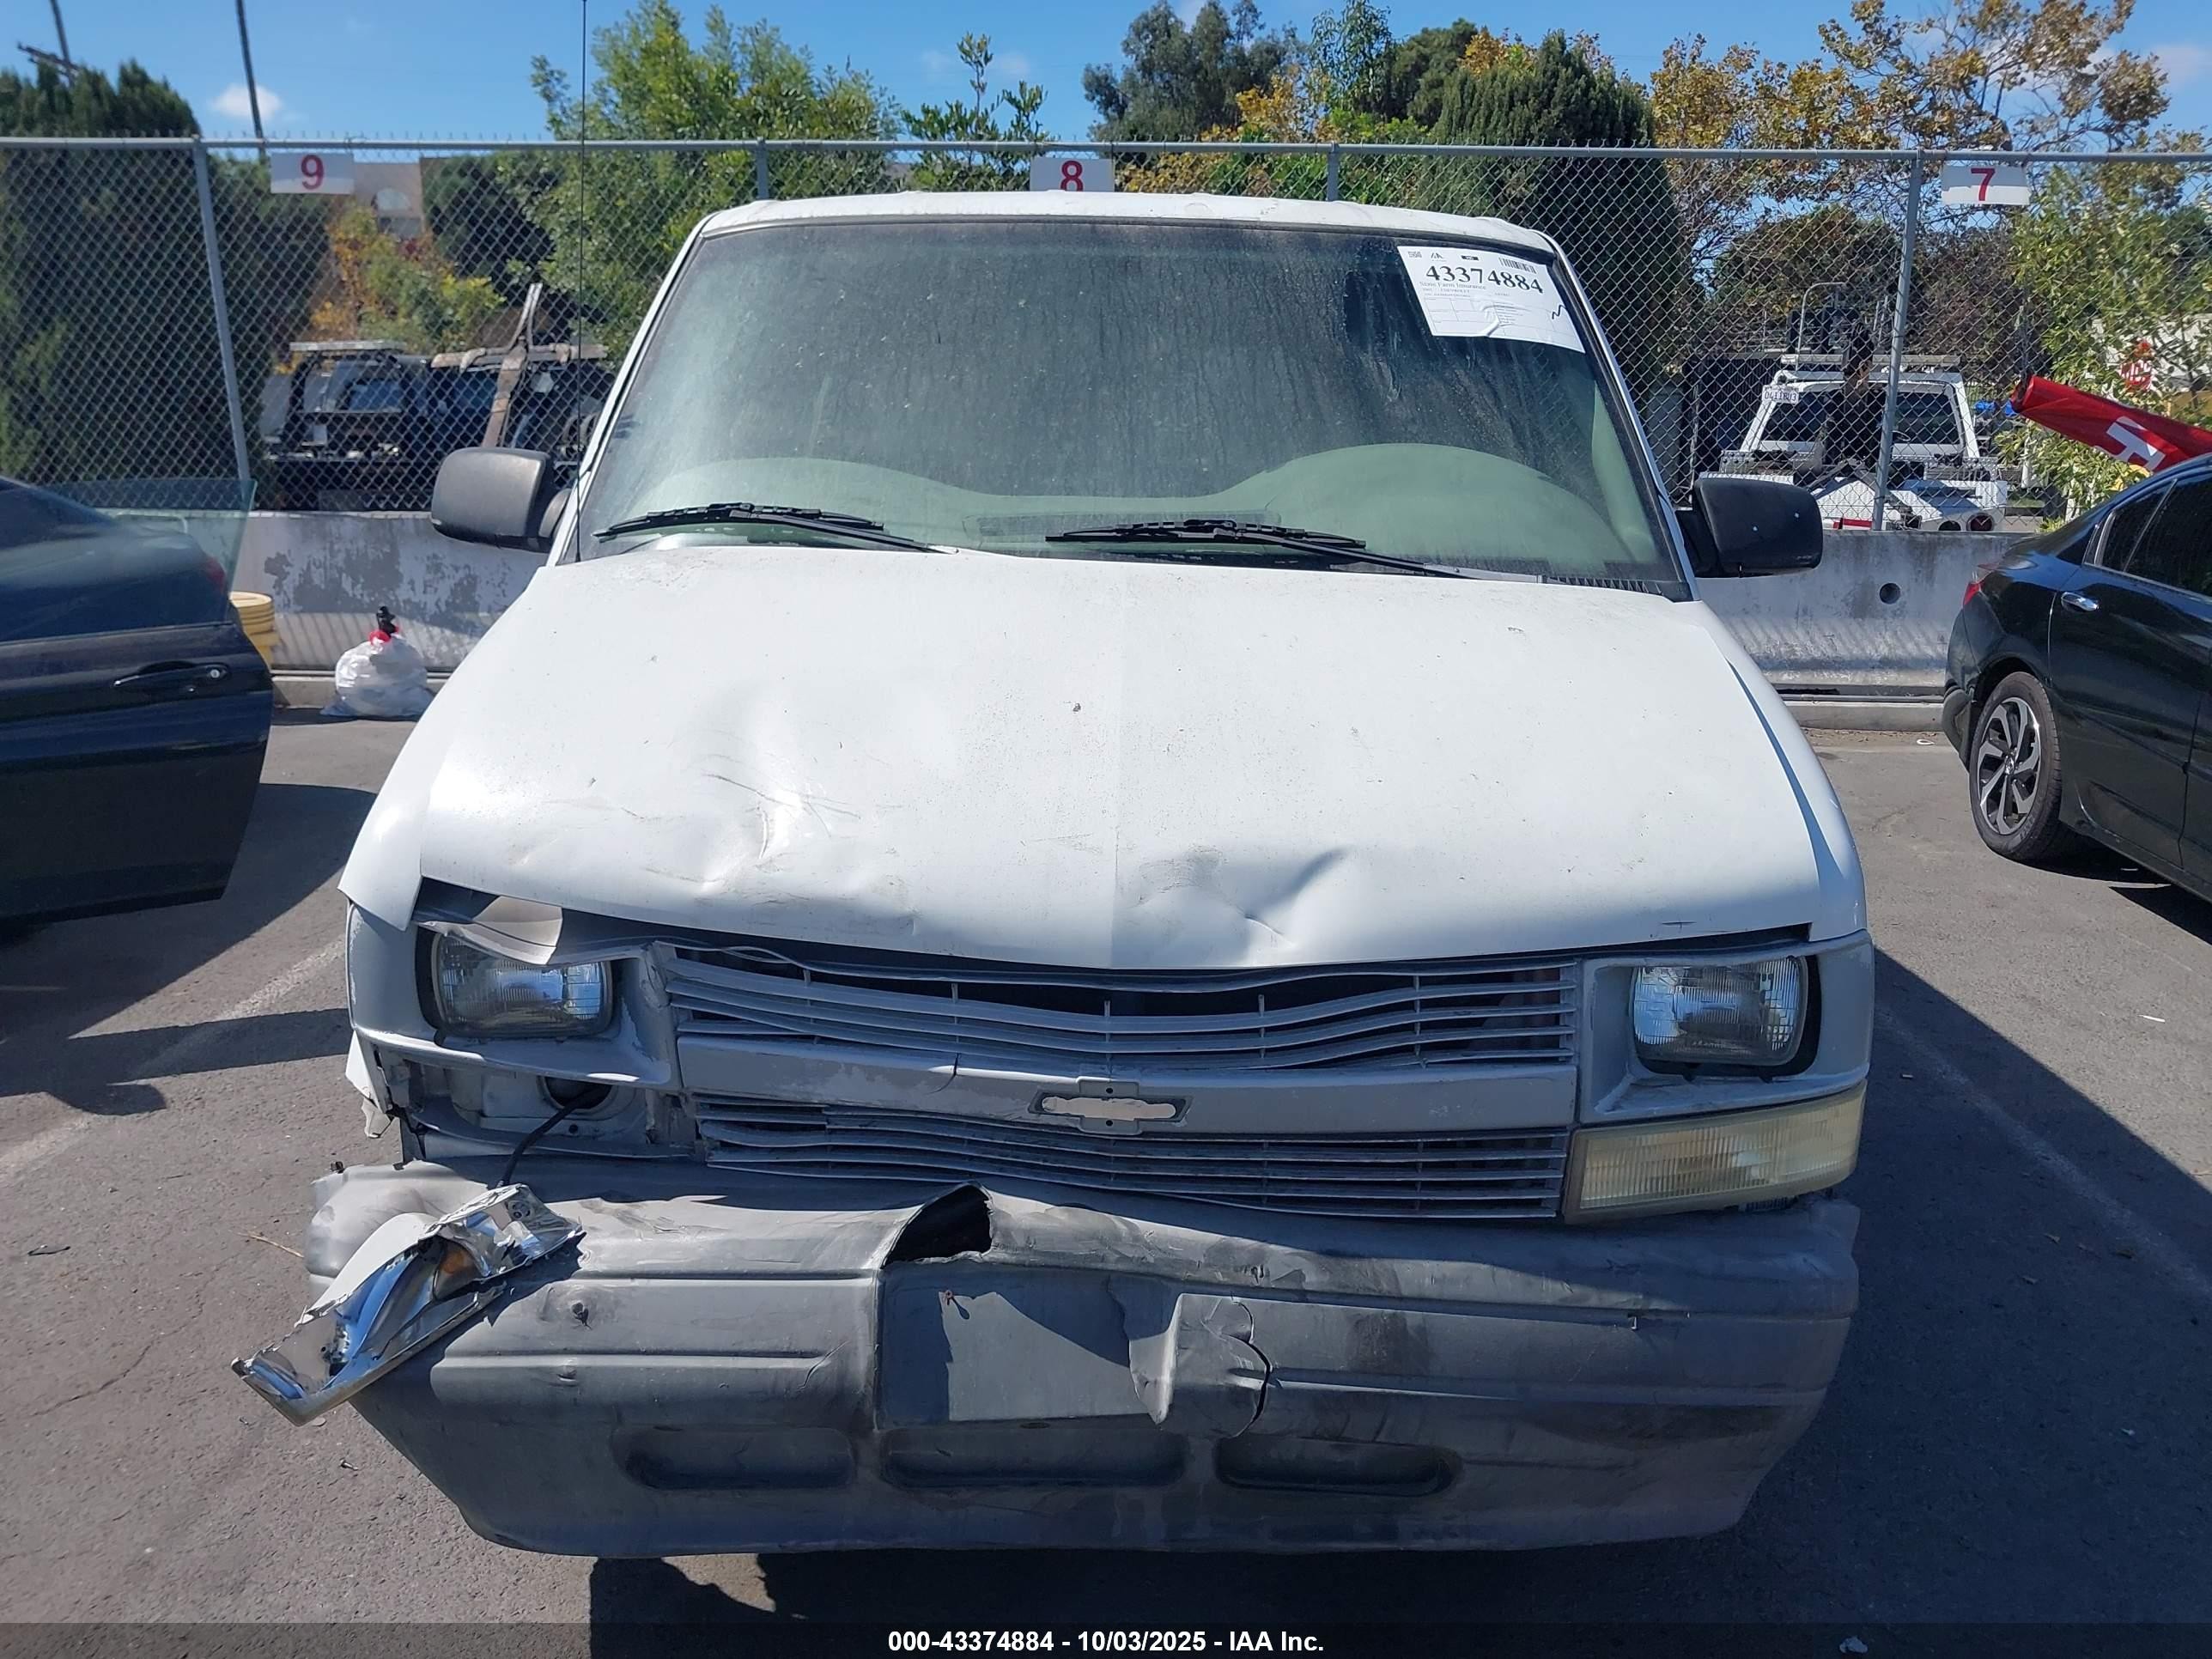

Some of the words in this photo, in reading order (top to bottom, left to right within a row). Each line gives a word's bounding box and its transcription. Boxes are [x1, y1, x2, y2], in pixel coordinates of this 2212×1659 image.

[301, 154, 325, 191] 9
[1060, 160, 1084, 191] 8
[1970, 167, 1996, 202] 7
[1425, 265, 1544, 294] 43374884
